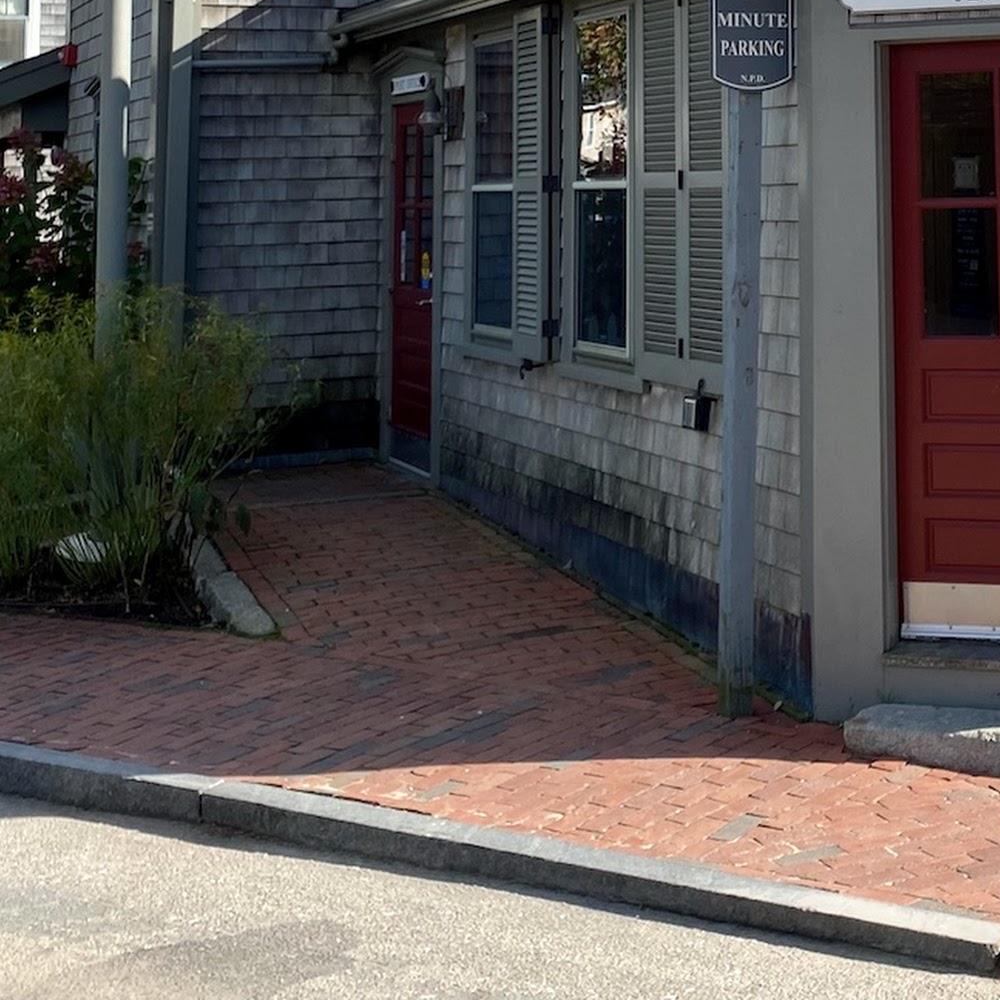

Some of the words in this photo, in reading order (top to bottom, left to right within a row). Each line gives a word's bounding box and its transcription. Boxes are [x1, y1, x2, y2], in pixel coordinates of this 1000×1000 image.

[717, 12, 788, 28] MINUTE
[720, 40, 785, 57] PARKING
[740, 74, 766, 83] N.P.D.
